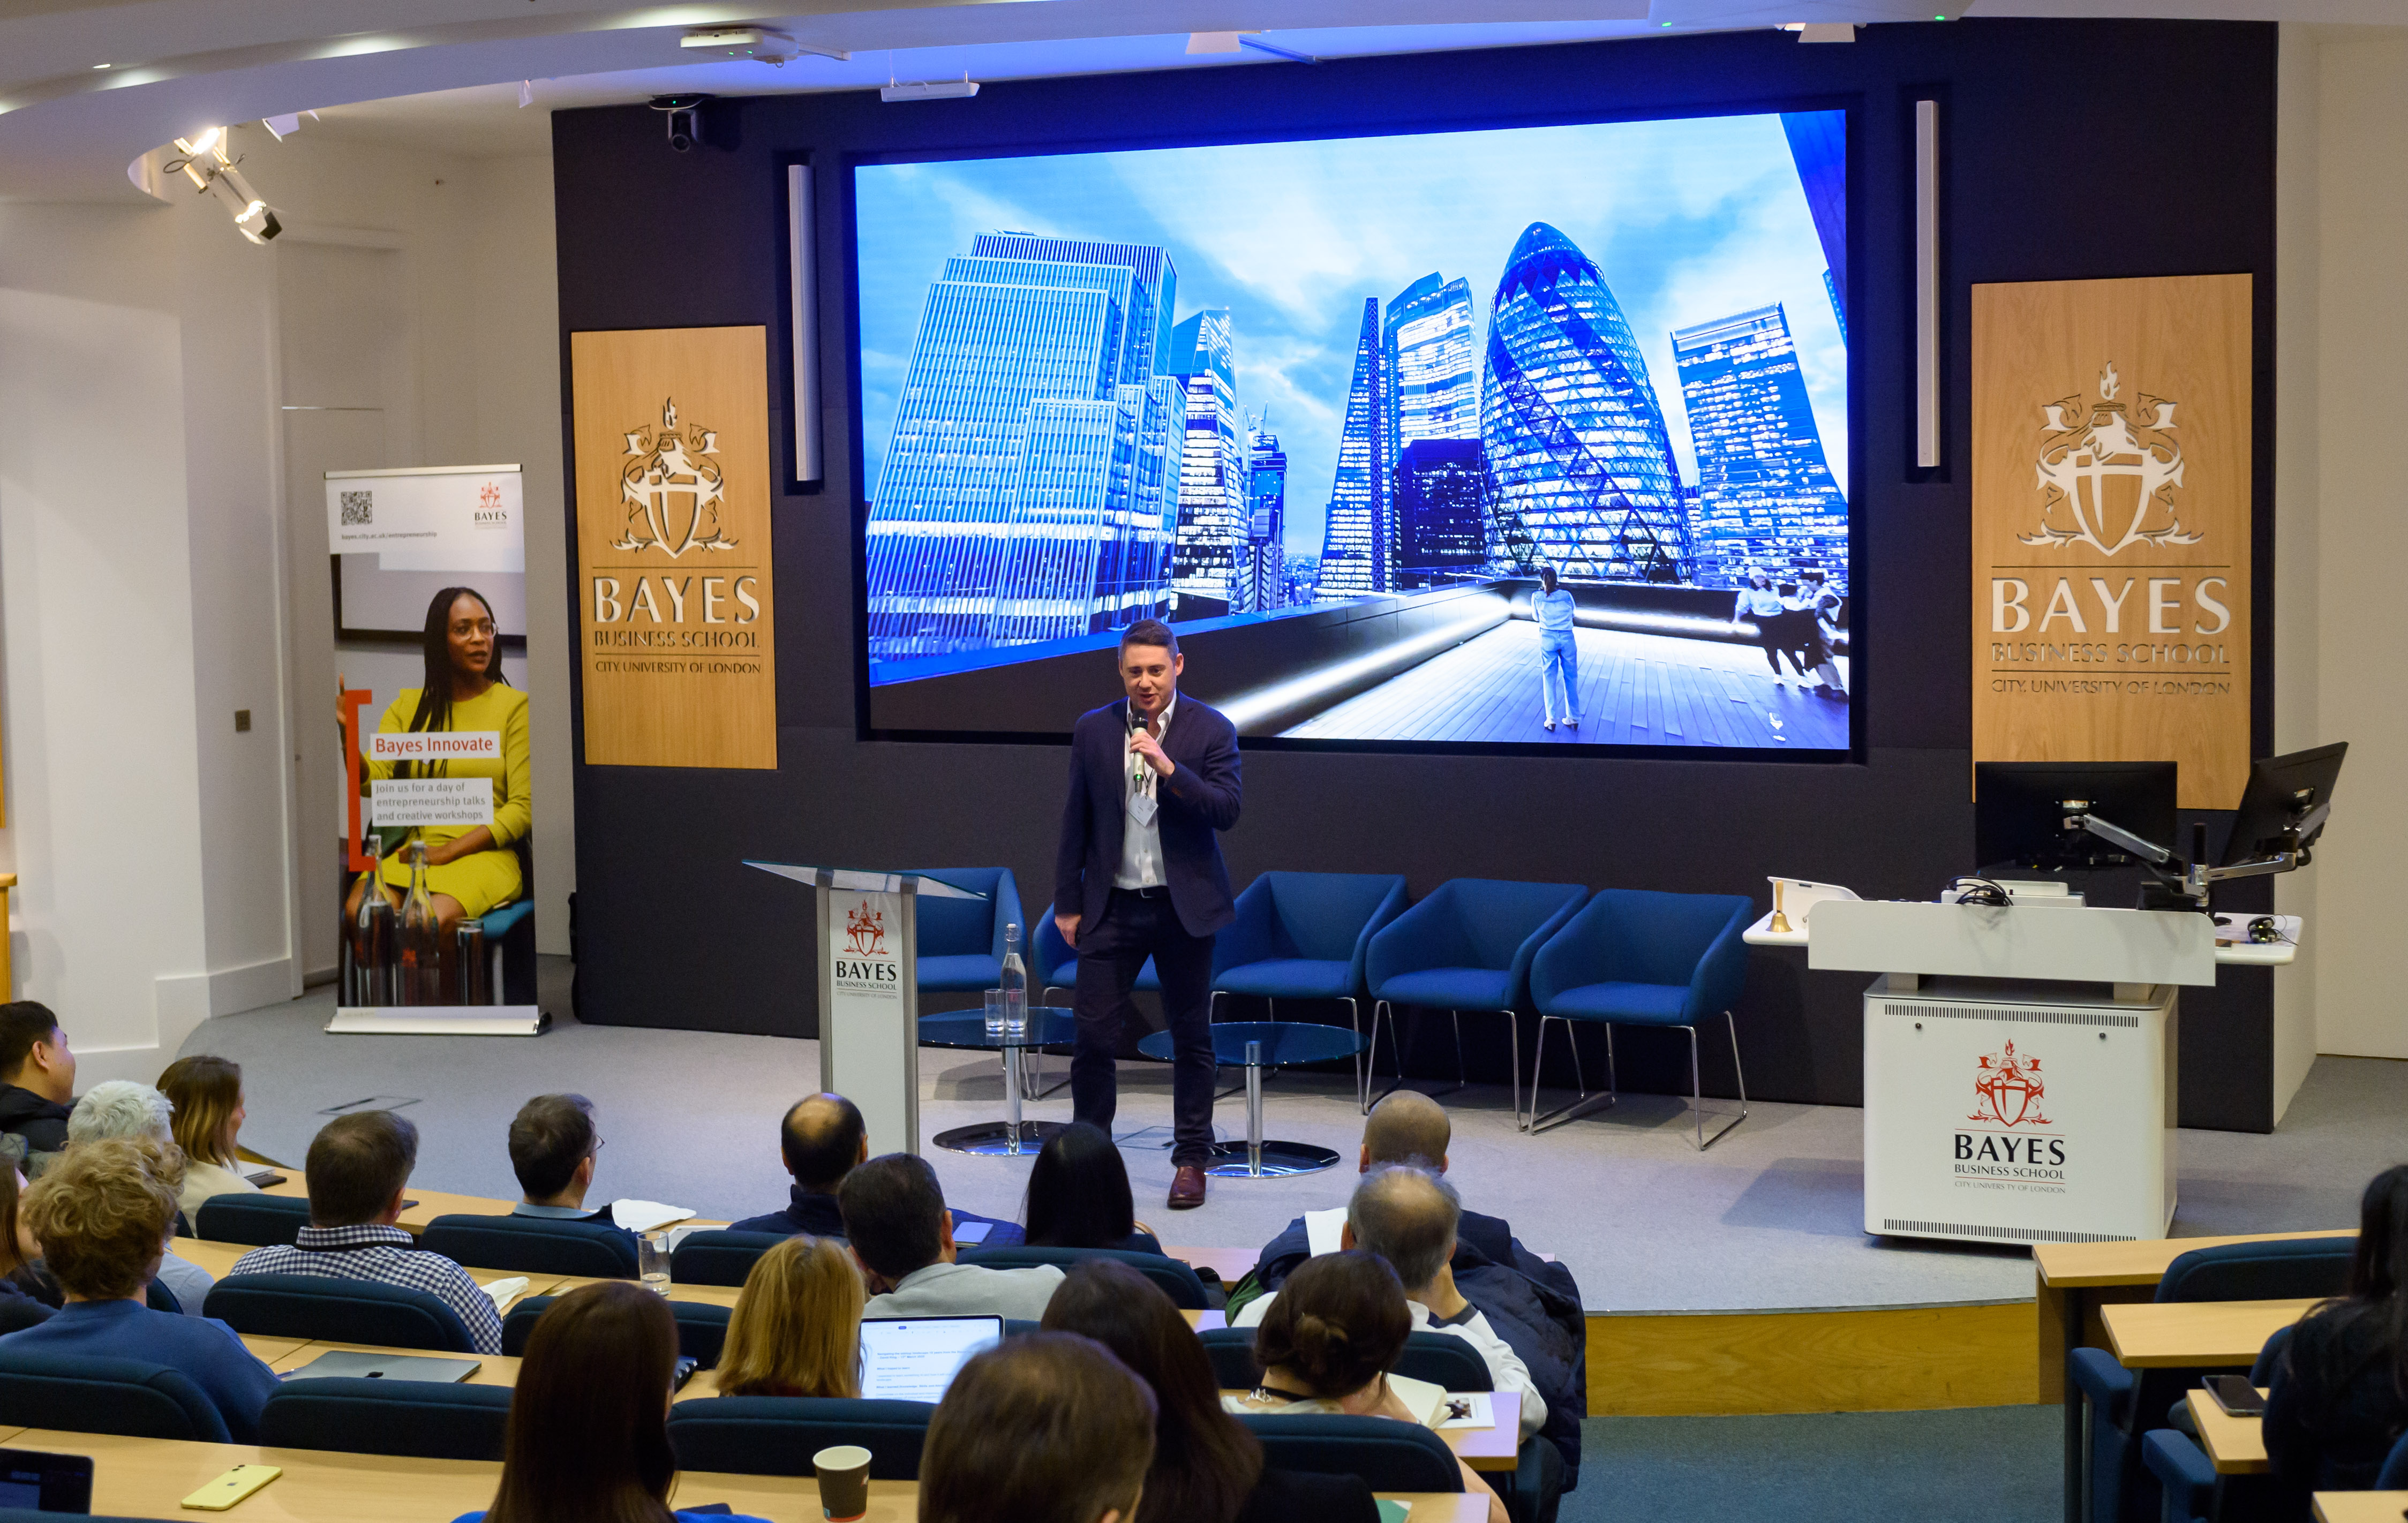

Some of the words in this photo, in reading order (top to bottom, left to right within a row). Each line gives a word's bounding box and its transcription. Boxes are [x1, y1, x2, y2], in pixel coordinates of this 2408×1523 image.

[474, 511, 507, 521] BAYES
[593, 575, 760, 624] BAYES
[1991, 576, 2231, 635] BAYES
[595, 631, 676, 647] BUSINESS
[682, 631, 760, 649] SCHOOL
[1992, 643, 2108, 662] BUSINESS
[2117, 643, 2230, 664] SCHOOL
[623, 661, 686, 673] UNIVERSITY
[689, 662, 704, 673] OF
[709, 663, 761, 674] LONDON
[2031, 680, 2122, 694] UNIVERSITY
[2127, 681, 2149, 695] OF
[2155, 681, 2231, 695] LONDON
[376, 738, 423, 756] Bayes
[428, 737, 493, 751] Innovate
[377, 784, 394, 794] Join
[412, 783, 425, 793] for
[437, 782, 453, 793] day
[456, 782, 465, 792] of
[377, 797, 460, 808] entrepreneurship
[463, 796, 485, 806] talks
[377, 810, 394, 821] and
[397, 810, 432, 820] creative
[434, 808, 483, 820] workshops
[836, 961, 897, 982] BAYES
[837, 980, 867, 988] BUSINESS
[868, 983, 897, 991] SCHOOL
[1955, 1134, 2065, 1166] BAYES
[1955, 1164, 2009, 1176] BUSINESS
[2013, 1167, 2065, 1179] SCHOOL
[1973, 1182, 2015, 1190] UNIVERSTY
[2030, 1186, 2065, 1194] LONDON
